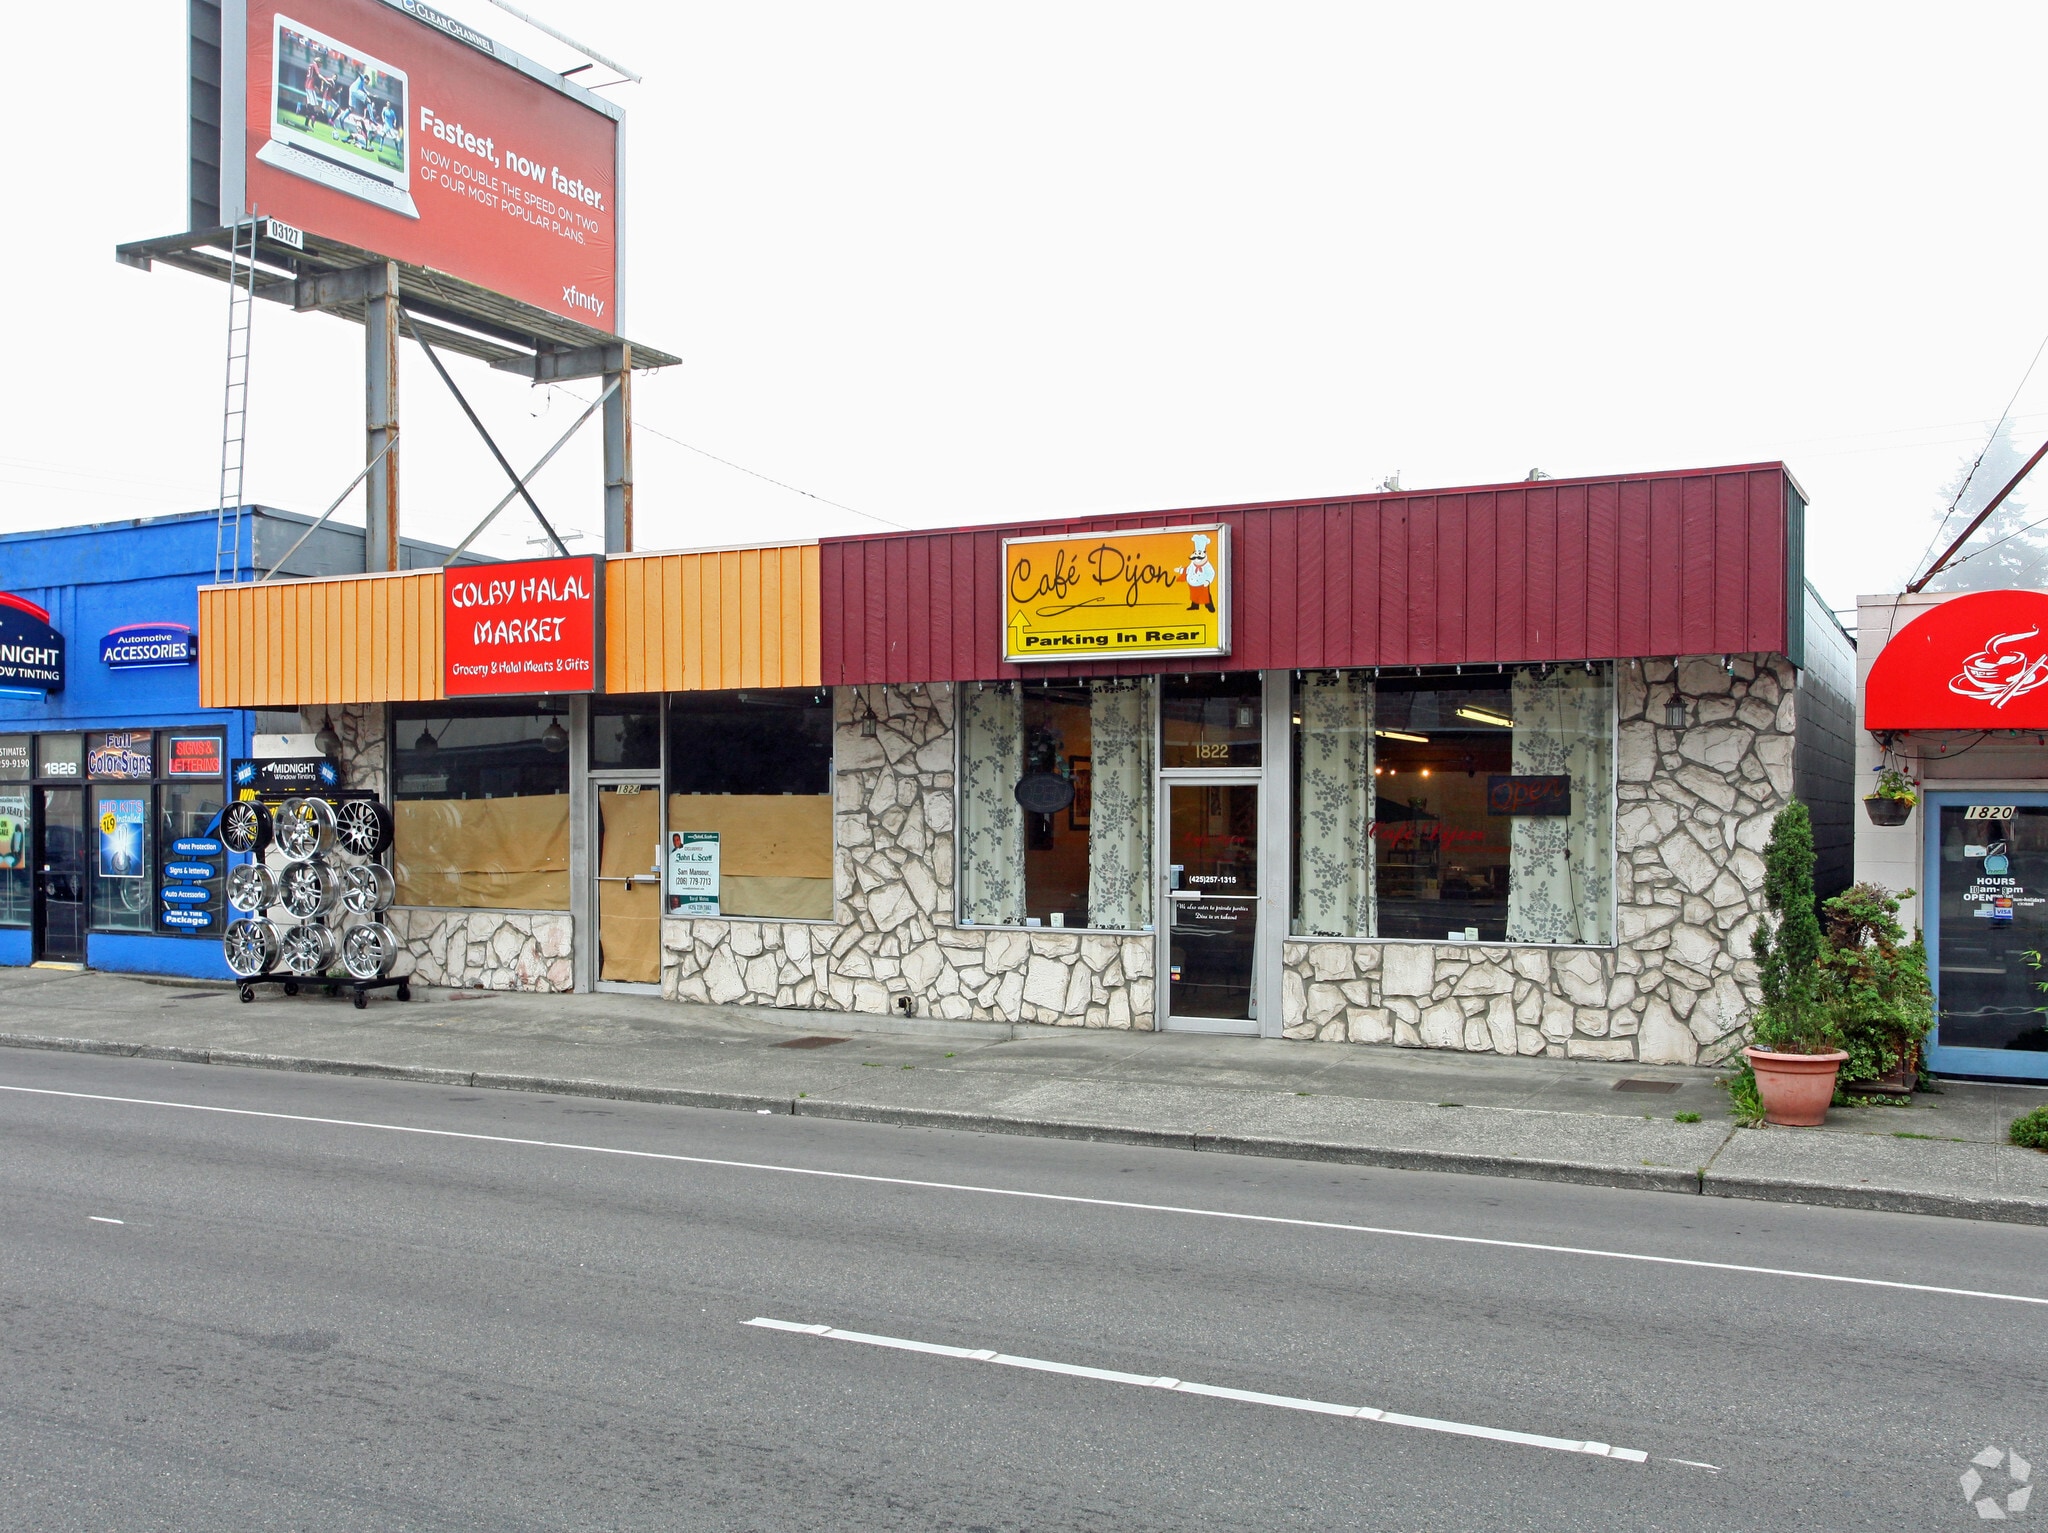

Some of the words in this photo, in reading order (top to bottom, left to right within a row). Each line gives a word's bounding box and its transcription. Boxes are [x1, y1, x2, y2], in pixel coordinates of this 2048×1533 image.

[420, 105, 500, 168] Fastest,
[506, 150, 547, 184] now
[551, 166, 606, 211] faster.
[420, 146, 451, 170] NOW
[453, 160, 499, 191] DOUBLE
[501, 181, 522, 201] THE
[523, 191, 556, 215] SPEED
[557, 206, 573, 223] ON
[576, 213, 599, 234] TWO
[420, 166, 438, 182] OF
[440, 174, 466, 196] OUR
[468, 185, 499, 209] MOST
[501, 199, 550, 231] POPULAR
[552, 220, 586, 246] PLANS.
[272, 221, 299, 245] 03127
[562, 285, 605, 318] xfinity
[1010, 548, 1081, 604] Café
[1087, 543, 1177, 608] Dijon
[451, 579, 516, 608] COLBY
[521, 575, 591, 604] HALAL
[473, 616, 567, 646] MARKET
[1025, 633, 1109, 646] Parking
[1117, 632, 1138, 643] In
[1145, 630, 1200, 642] Rear
[117, 633, 173, 644] Automotive
[0, 644, 59, 666] NIGHT
[103, 642, 188, 662] ACCESSORIES
[18, 668, 60, 681] TINTING
[452, 661, 488, 678] Grocery
[490, 660, 499, 675] &
[499, 660, 522, 674] Halal
[523, 659, 554, 673] Meats
[556, 658, 563, 673] &
[564, 657, 590, 672] Gifts
[105, 732, 132, 749] Full
[176, 741, 205, 756] SIGNS
[206, 740, 213, 756] &
[1196, 743, 1230, 759] 1822
[0, 758, 30, 769] 59-9190
[44, 762, 77, 775] 1826
[88, 750, 119, 774] Color
[121, 749, 151, 779] Signs
[171, 758, 219, 772] LETTERING
[273, 763, 315, 774] MIDNIGHT
[297, 773, 316, 781] Tinting
[617, 784, 640, 794] 1824
[1491, 779, 1566, 812] Open
[99, 801, 118, 813] HID
[120, 801, 143, 813] KITS
[1969, 806, 2012, 819] 1820
[675, 852, 691, 863] John
[697, 853, 713, 862] Scott
[169, 866, 183, 876] Signs
[677, 867, 688, 876] Sam
[1188, 875, 1237, 884] (425)257-1315
[1976, 877, 2016, 886] HOURS
[164, 890, 178, 898] Auto
[178, 890, 206, 899] Accessories
[1963, 893, 1994, 901] OPEN
[165, 915, 208, 926] Packages
